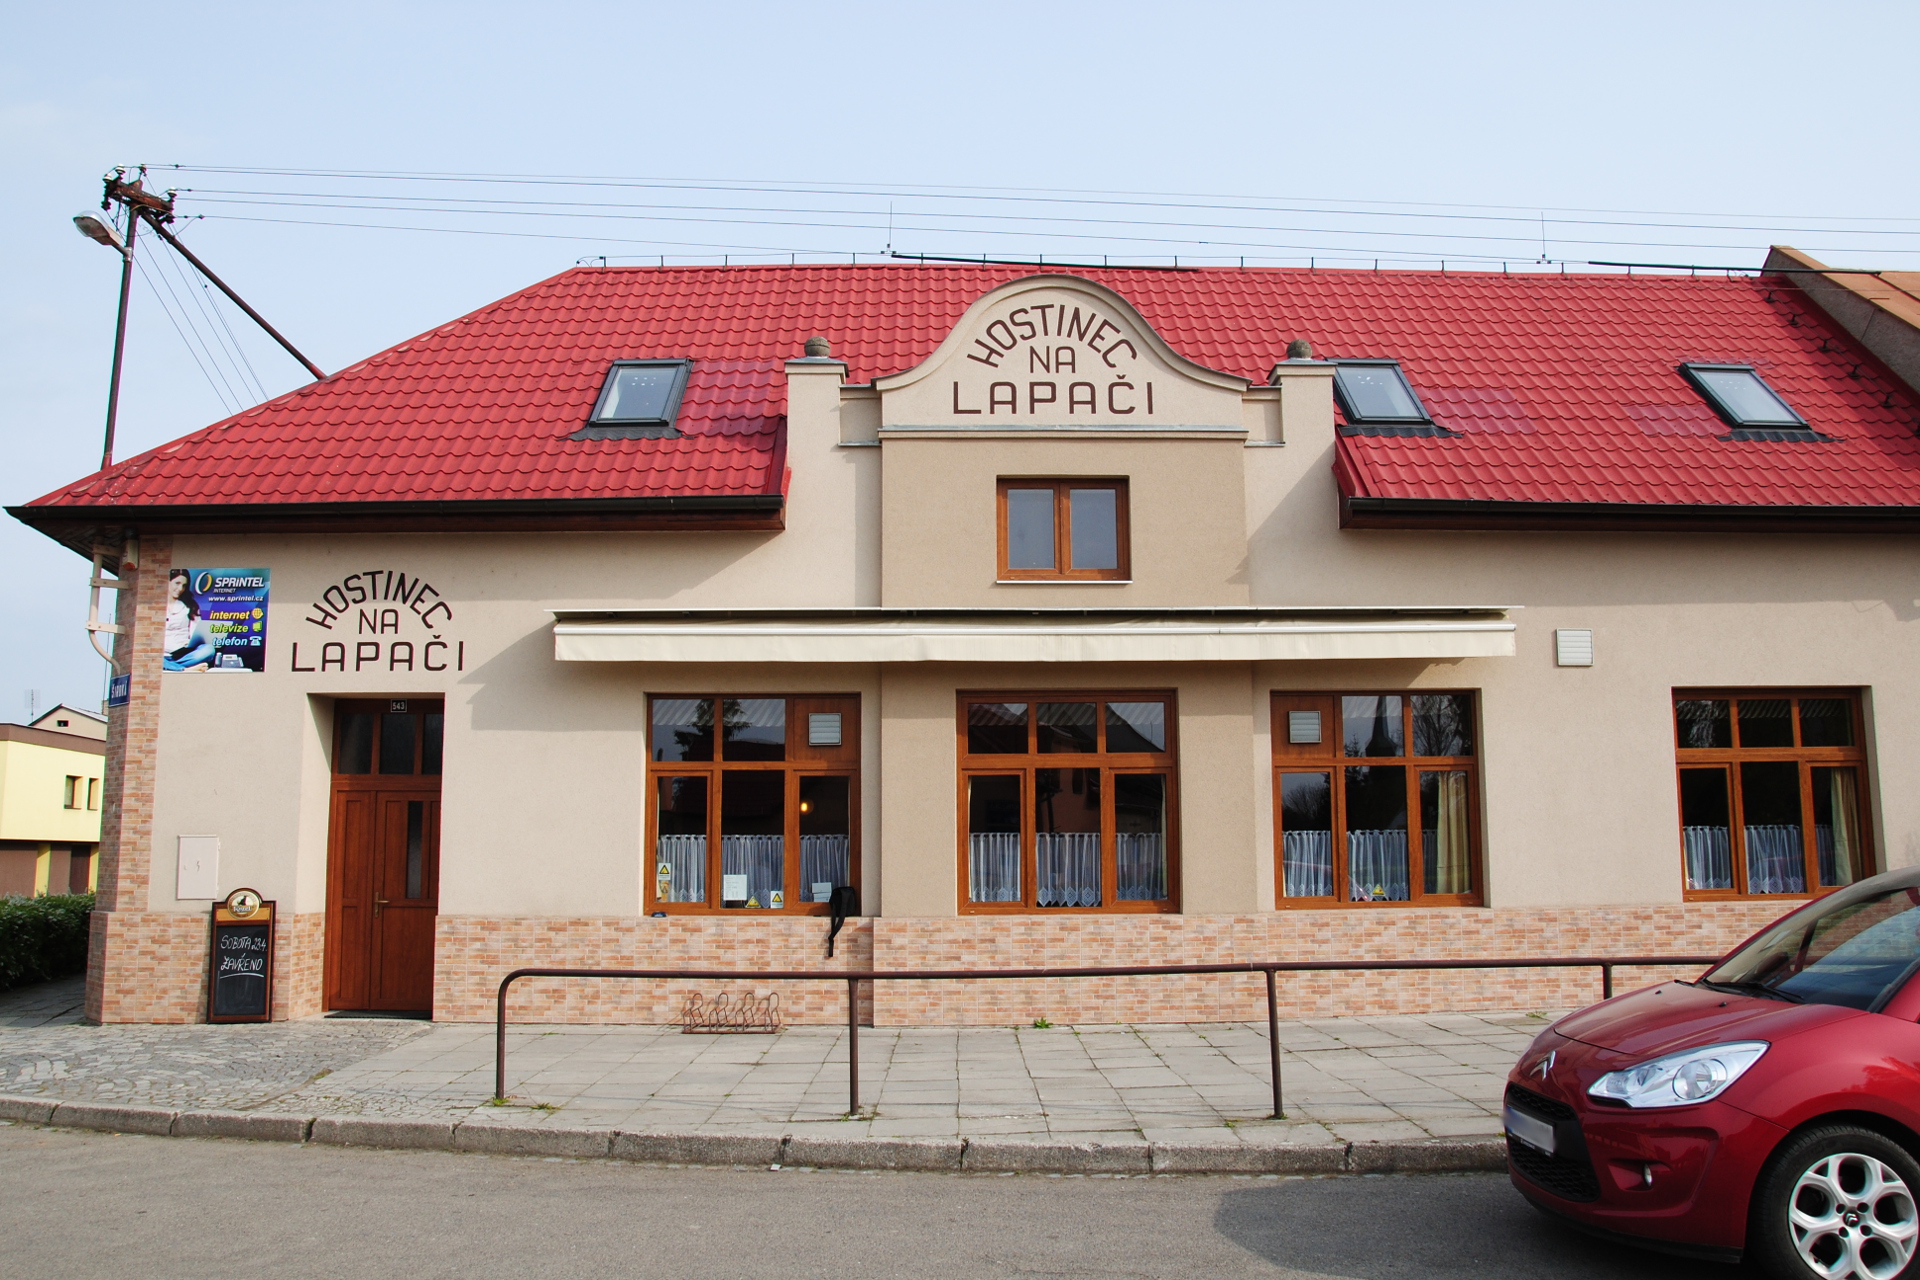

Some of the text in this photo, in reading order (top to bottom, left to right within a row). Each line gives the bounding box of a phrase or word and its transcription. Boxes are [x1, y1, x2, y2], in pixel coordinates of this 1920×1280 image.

[967, 304, 1137, 368] HOSTINEC
[1030, 346, 1076, 374] NA
[953, 374, 1154, 415] LAPAČI
[305, 570, 452, 630] HOSTINEC
[209, 610, 250, 620] internet
[358, 609, 400, 634] NA
[209, 623, 249, 633] televize
[212, 637, 248, 646] telefon
[291, 634, 464, 672] LAPAČI
[392, 701, 405, 710] 543
[220, 934, 252, 950] SOBOTA
